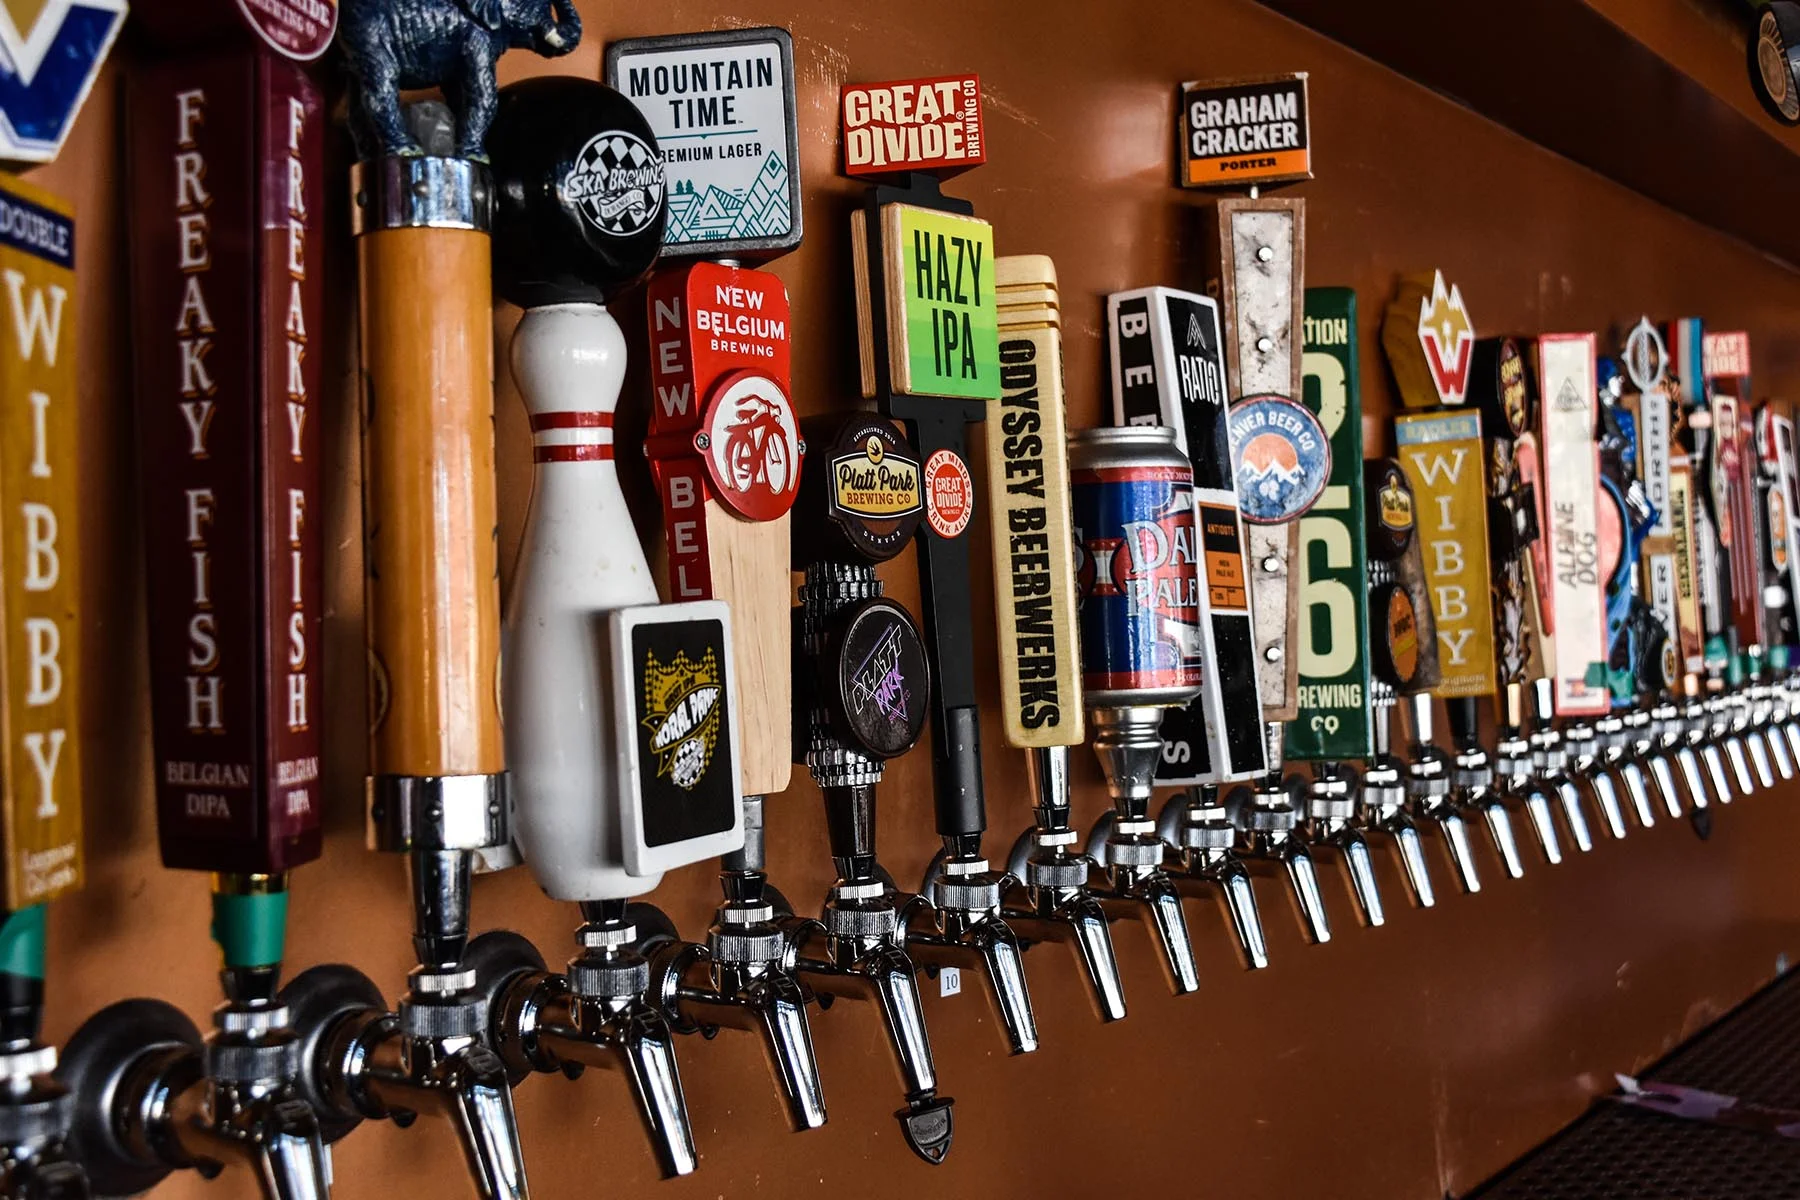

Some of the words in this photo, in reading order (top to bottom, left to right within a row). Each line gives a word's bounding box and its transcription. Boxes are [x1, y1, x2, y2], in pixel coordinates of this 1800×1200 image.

[629, 57, 773, 97] MOUNTAIN
[963, 79, 976, 97] CO
[668, 95, 737, 129] TIME
[845, 80, 961, 128] GREAT
[1190, 91, 1298, 129] GRAHAM
[847, 120, 966, 166] DIVIDE
[965, 97, 981, 158] BREWING
[1192, 121, 1299, 156] CRACKER
[660, 146, 713, 164] REMIUM
[719, 142, 763, 160] LAGER
[1220, 157, 1277, 171] PORTER
[569, 172, 605, 199] SKA
[0, 199, 70, 257] DOUBLE
[175, 89, 217, 458] FREAKY
[287, 97, 308, 461] FREAKY
[914, 229, 982, 308] HAZY
[715, 285, 764, 310] NEW
[696, 309, 785, 341] BELGIUM
[1302, 317, 1348, 346] TION
[655, 297, 690, 417] NEW
[711, 339, 774, 357] BREWING
[932, 307, 978, 380] IPA
[1180, 354, 1220, 406] RATIO
[998, 338, 1046, 500] ODYSSEY
[1231, 411, 1265, 450] ENVER
[1268, 411, 1303, 436] BEER
[1298, 431, 1316, 452] CO
[1406, 421, 1471, 439] RADLER
[839, 464, 877, 490] Platt
[878, 465, 915, 491] Park
[925, 454, 946, 489] GREAT
[948, 454, 971, 486] MINDS
[936, 476, 962, 492] GREAT
[847, 492, 894, 505] BREWING
[896, 493, 911, 504] CO
[936, 491, 964, 508] DIVIDE
[927, 502, 951, 534] DRINK
[954, 502, 972, 534] ALIKE
[5, 268, 66, 819] WIBBY
[1410, 448, 1474, 667] WIBBY
[1577, 532, 1597, 586] DOG
[185, 489, 226, 733] FISH
[287, 488, 309, 732] FISH
[1125, 577, 1198, 617] PALE
[1007, 506, 1060, 730] BEERWERKS
[875, 668, 905, 716] PARK
[1297, 684, 1362, 708] REWING
[655, 700, 692, 748] MORAL
[689, 687, 719, 725] PANIC
[166, 760, 249, 786] BELGIAN
[276, 756, 318, 787] BELGIAN
[186, 793, 231, 819] DIPA
[287, 789, 310, 816] DIPA
[945, 974, 959, 990] 10
